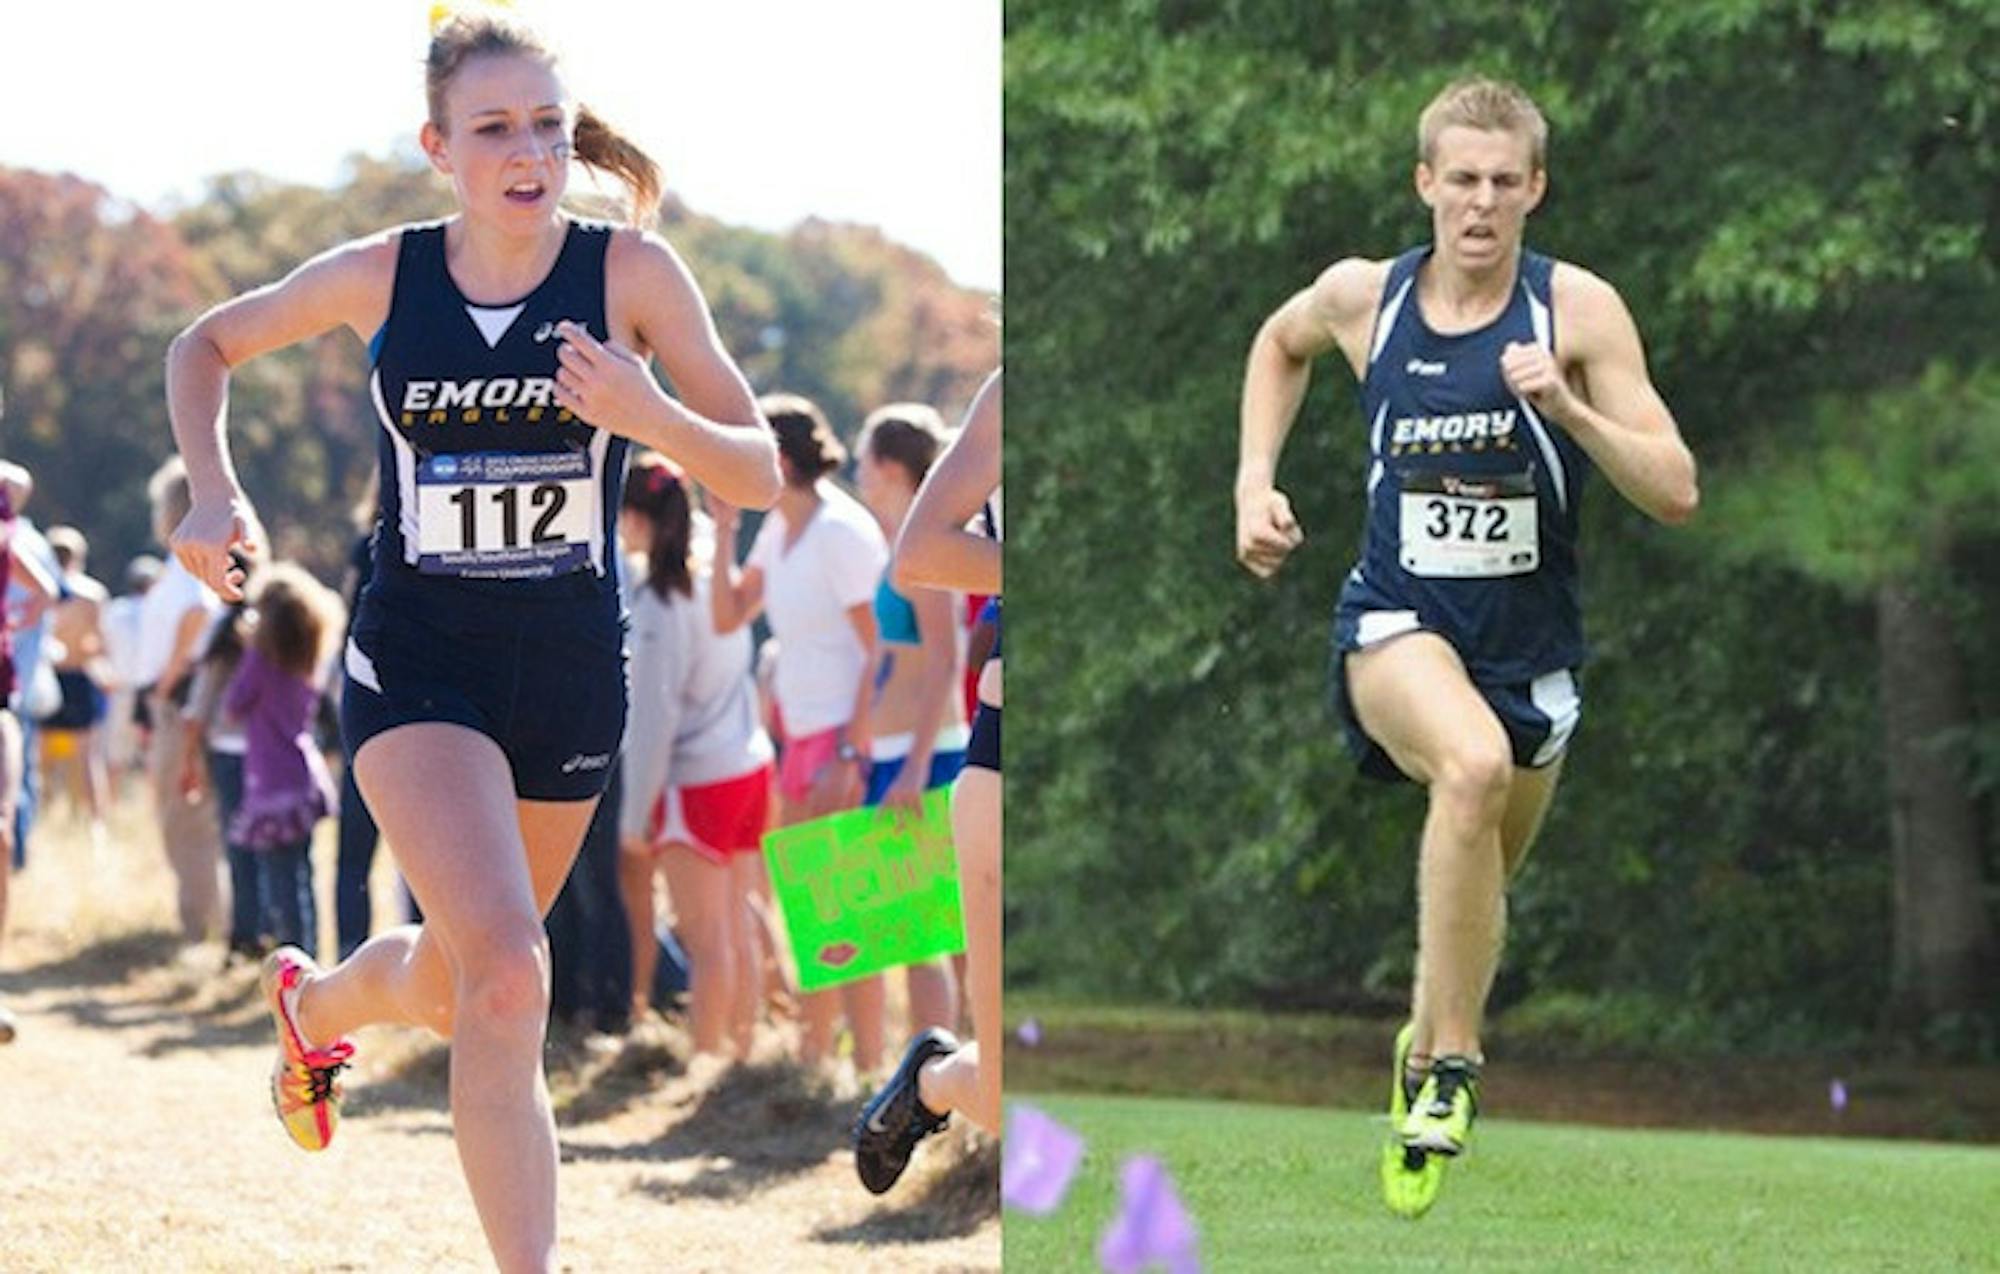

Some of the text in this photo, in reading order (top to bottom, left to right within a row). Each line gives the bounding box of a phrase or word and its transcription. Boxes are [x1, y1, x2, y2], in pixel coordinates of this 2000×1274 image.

[402, 376, 561, 411] EMOR
[1392, 409, 1517, 443] EMORY
[484, 461, 586, 477] CHAMPIONSHIPS
[450, 485, 567, 549] 112
[1426, 500, 1508, 542] 372
